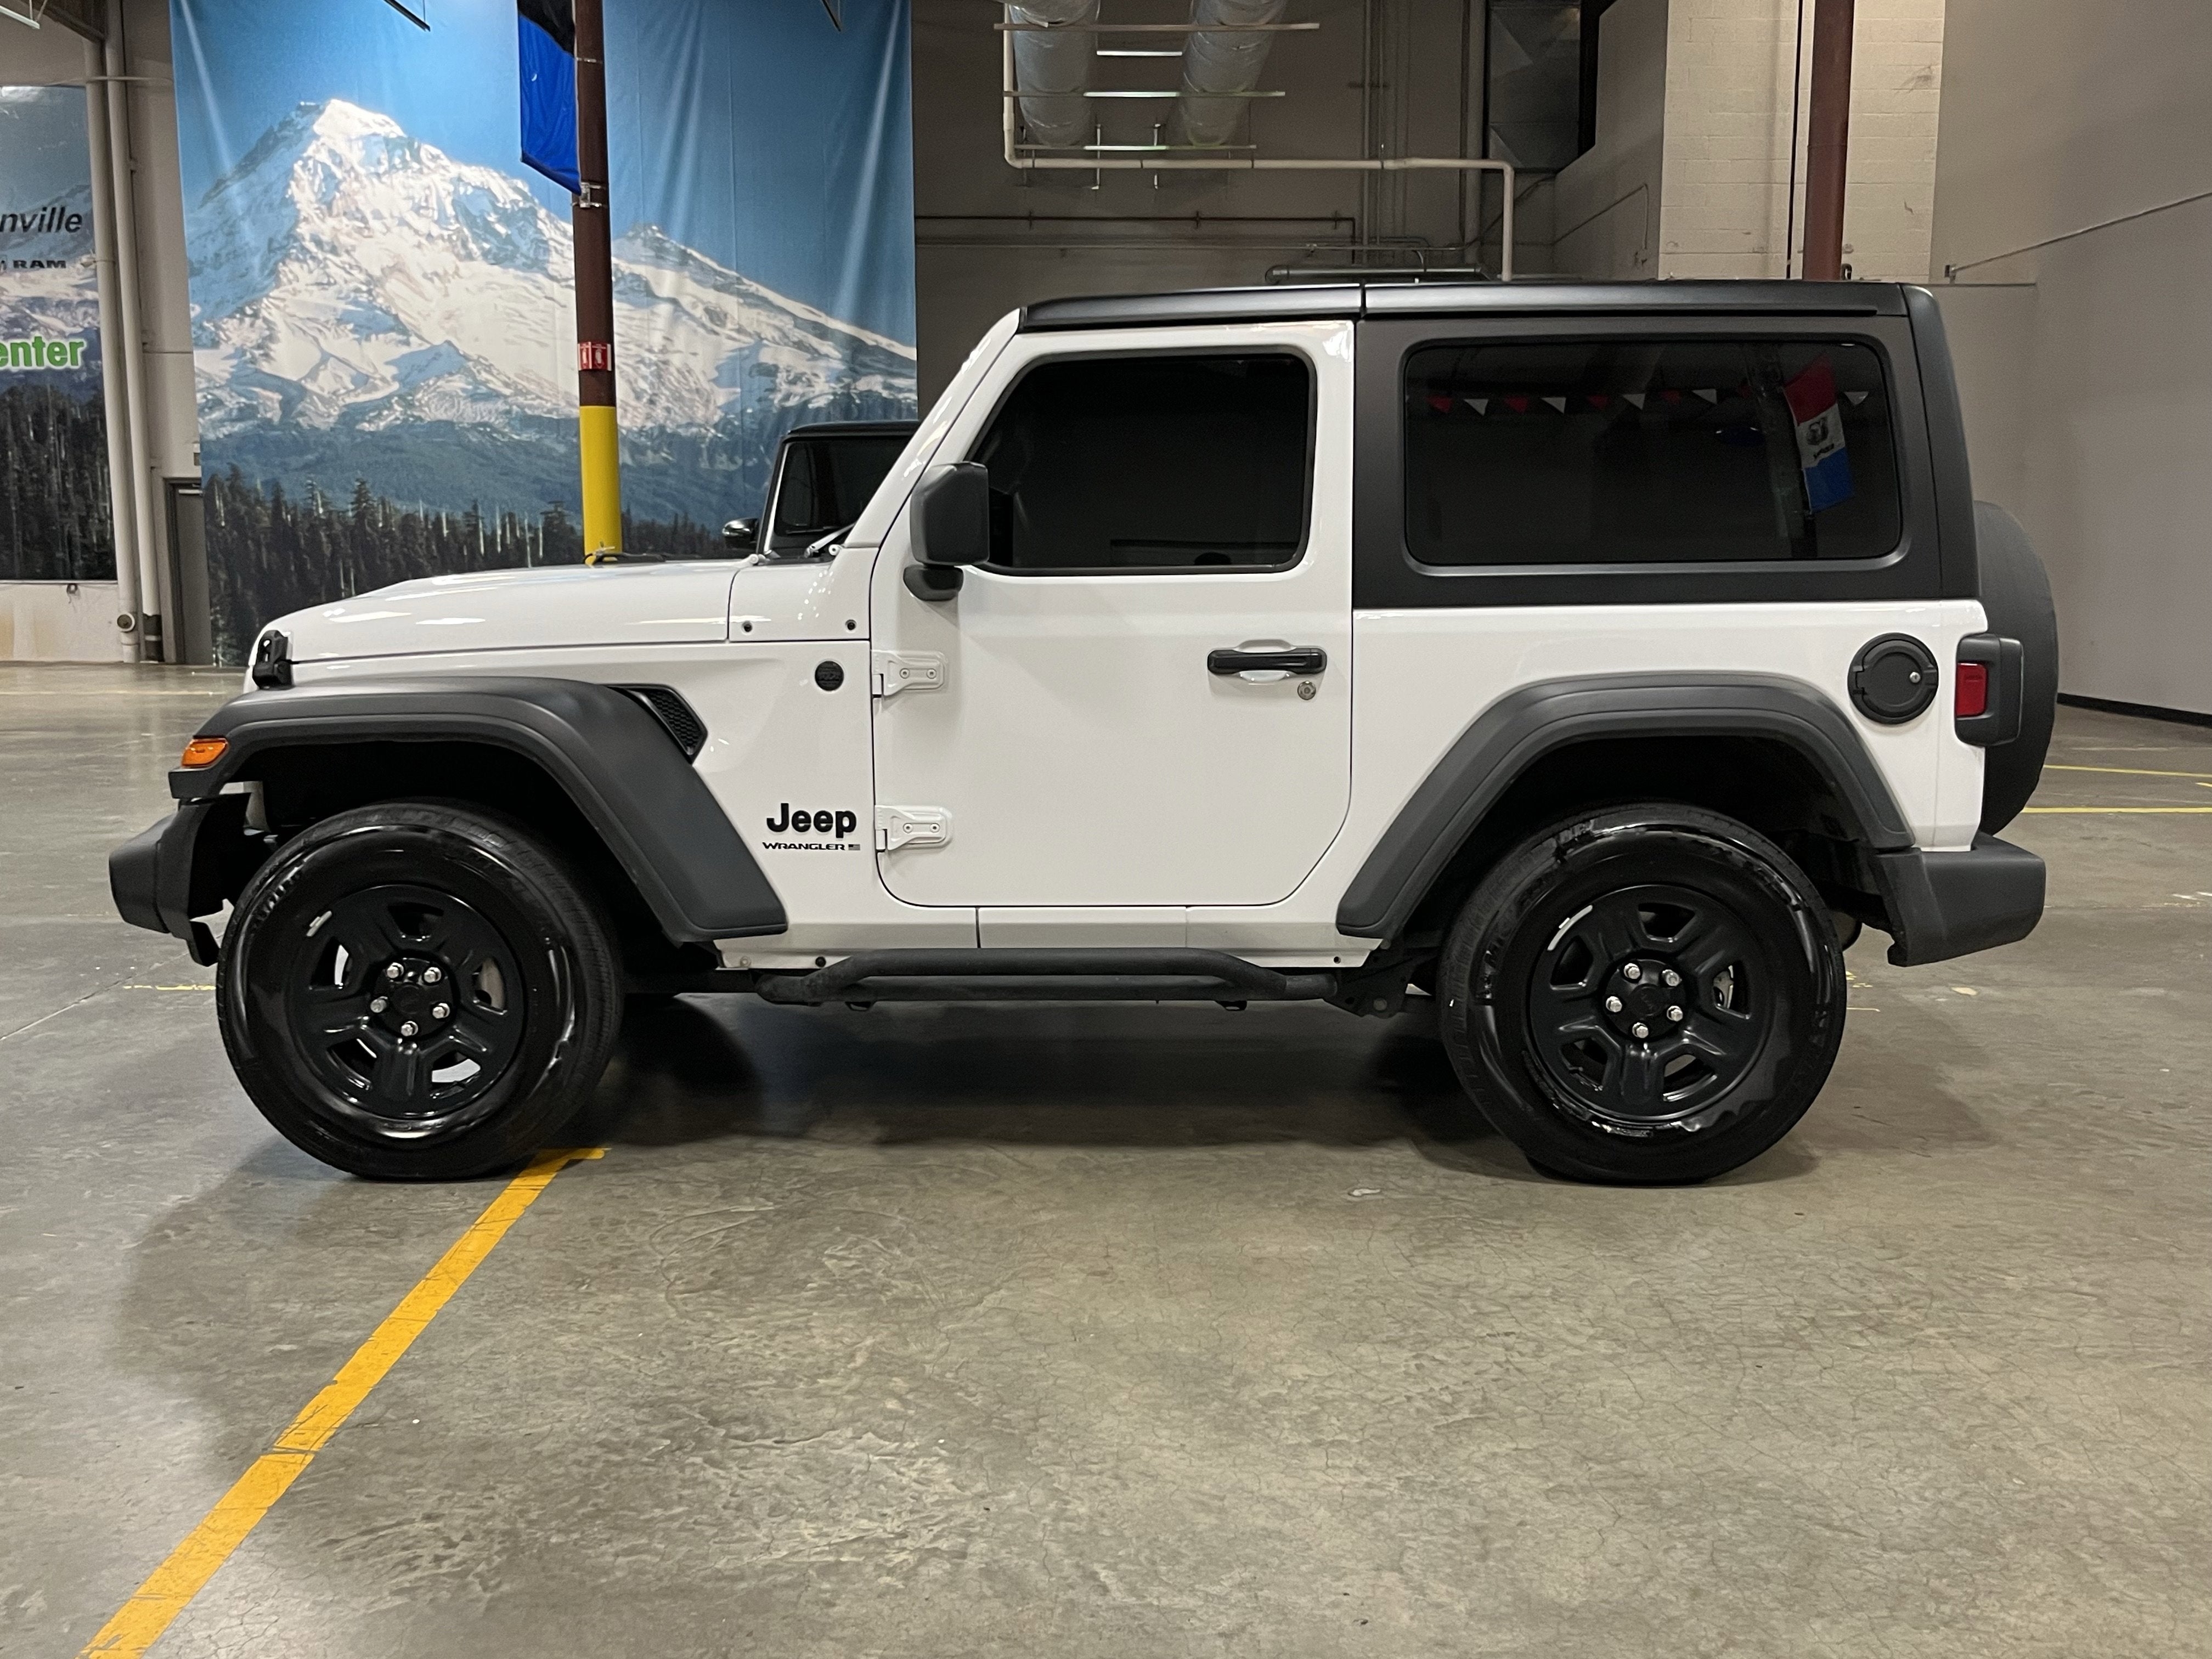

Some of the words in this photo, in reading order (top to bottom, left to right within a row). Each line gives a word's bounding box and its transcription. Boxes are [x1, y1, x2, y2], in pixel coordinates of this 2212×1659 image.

[0, 206, 82, 233] nville
[13, 259, 66, 269] RAM
[766, 803, 857, 838] Jeep
[762, 842, 845, 851] WRANGLER
